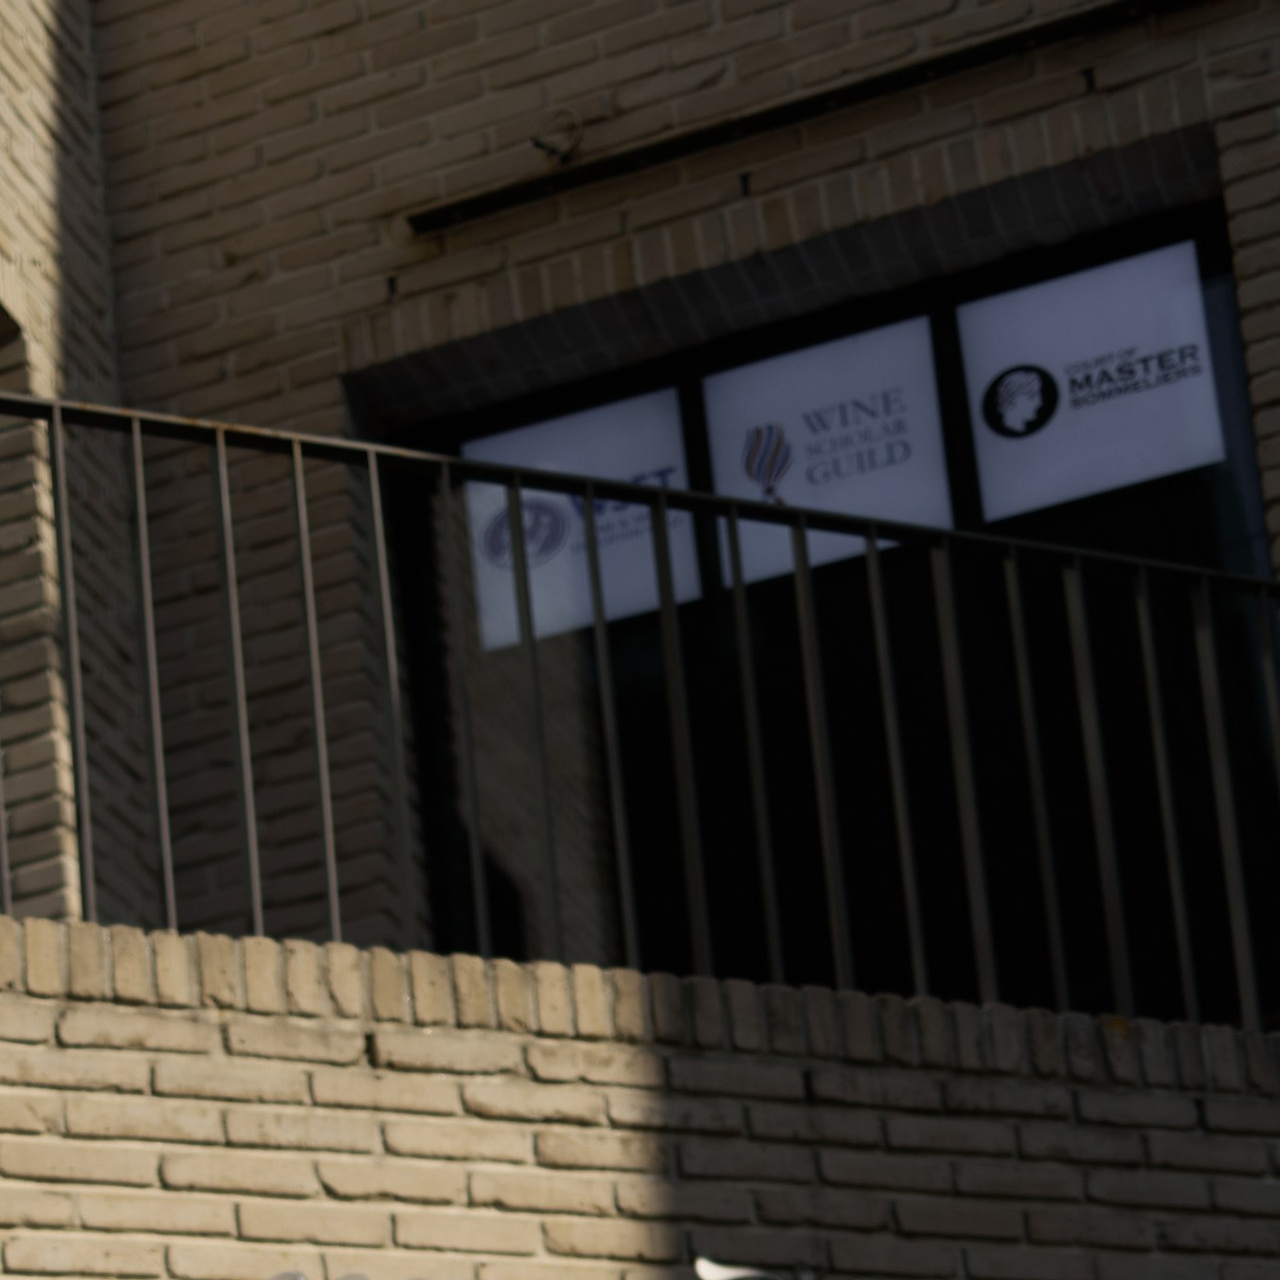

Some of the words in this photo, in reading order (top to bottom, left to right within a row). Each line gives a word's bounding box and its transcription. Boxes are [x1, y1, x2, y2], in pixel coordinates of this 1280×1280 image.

[1068, 343, 1201, 395] MASTER
[801, 387, 909, 435] WINE
[805, 439, 913, 486] GUILD
